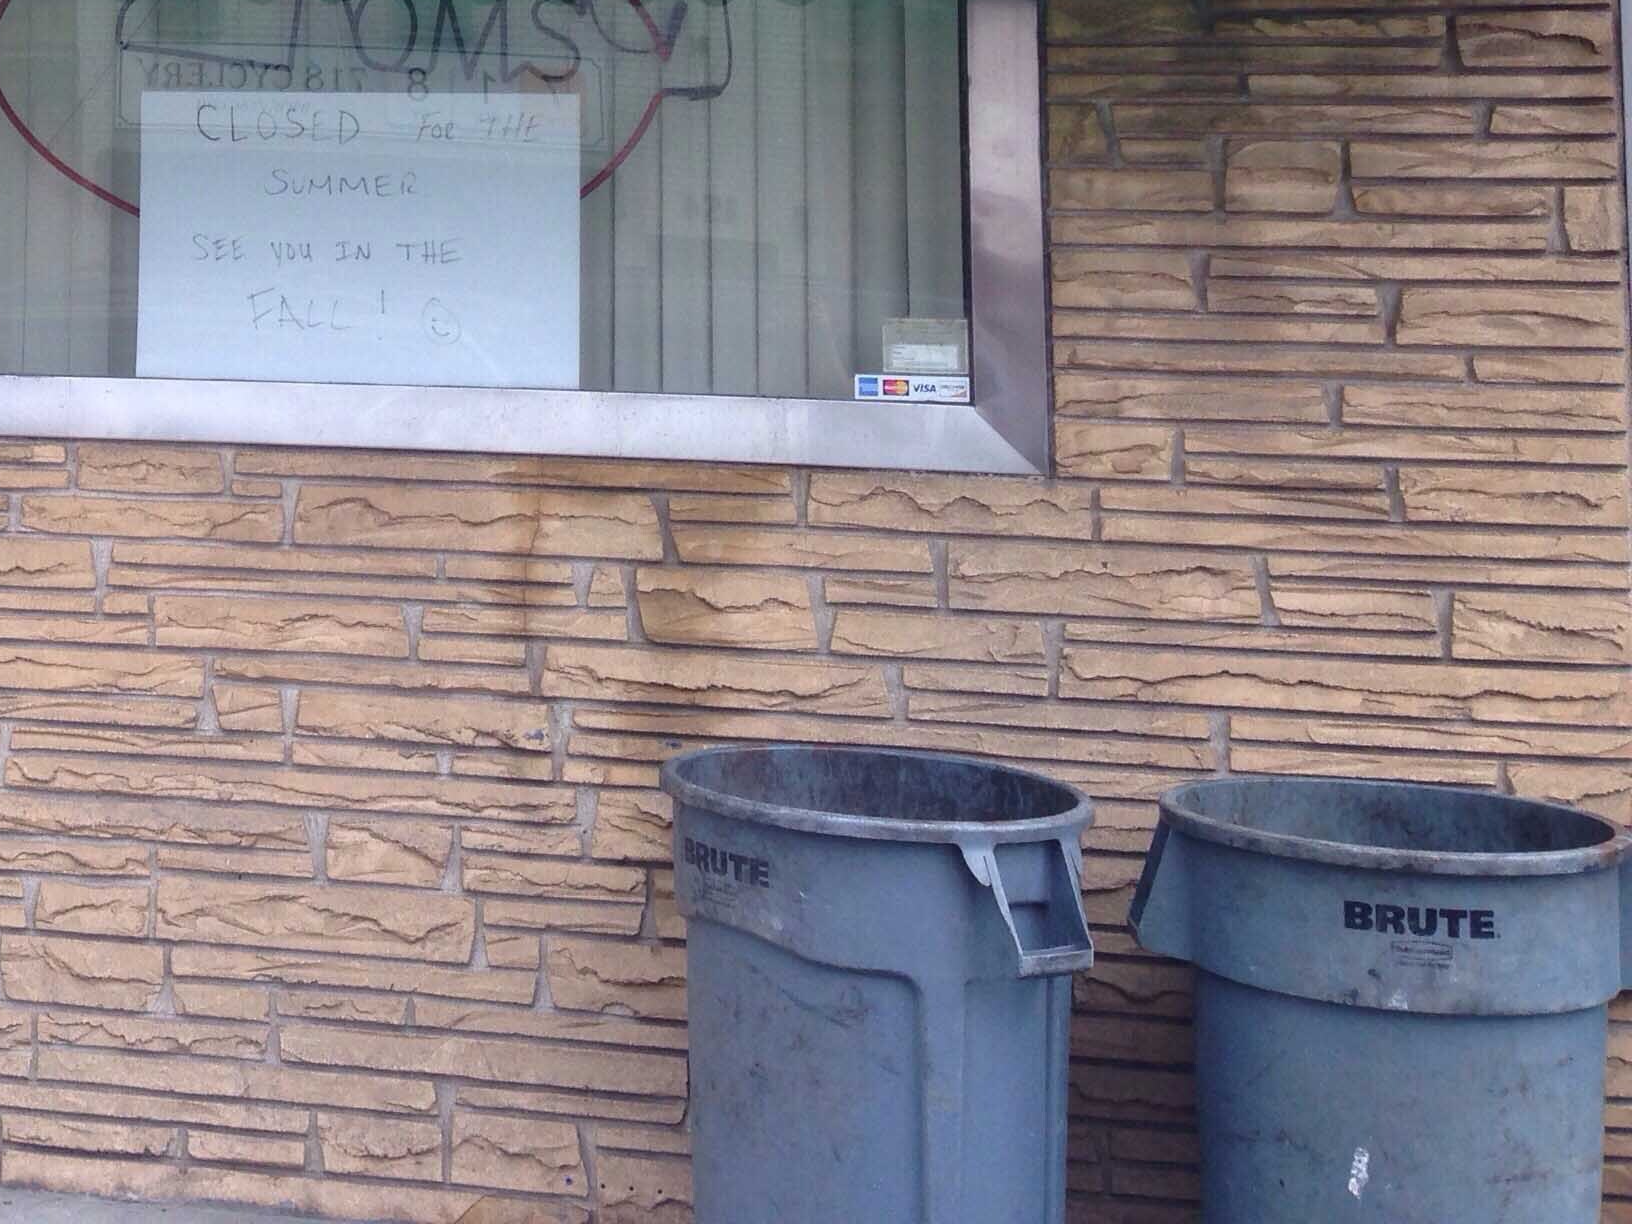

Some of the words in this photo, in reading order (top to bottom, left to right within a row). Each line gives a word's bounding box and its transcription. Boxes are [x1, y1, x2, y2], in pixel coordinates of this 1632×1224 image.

[197, 104, 360, 144] CLOSED
[264, 168, 418, 197] SUMMER
[192, 232, 244, 262] SEE
[270, 241, 313, 267] YOU
[335, 241, 372, 261] IN
[395, 238, 463, 264] THE
[912, 383, 937, 393] VISA
[683, 836, 770, 889] BRUTE
[1343, 900, 1496, 939] BRUTE
